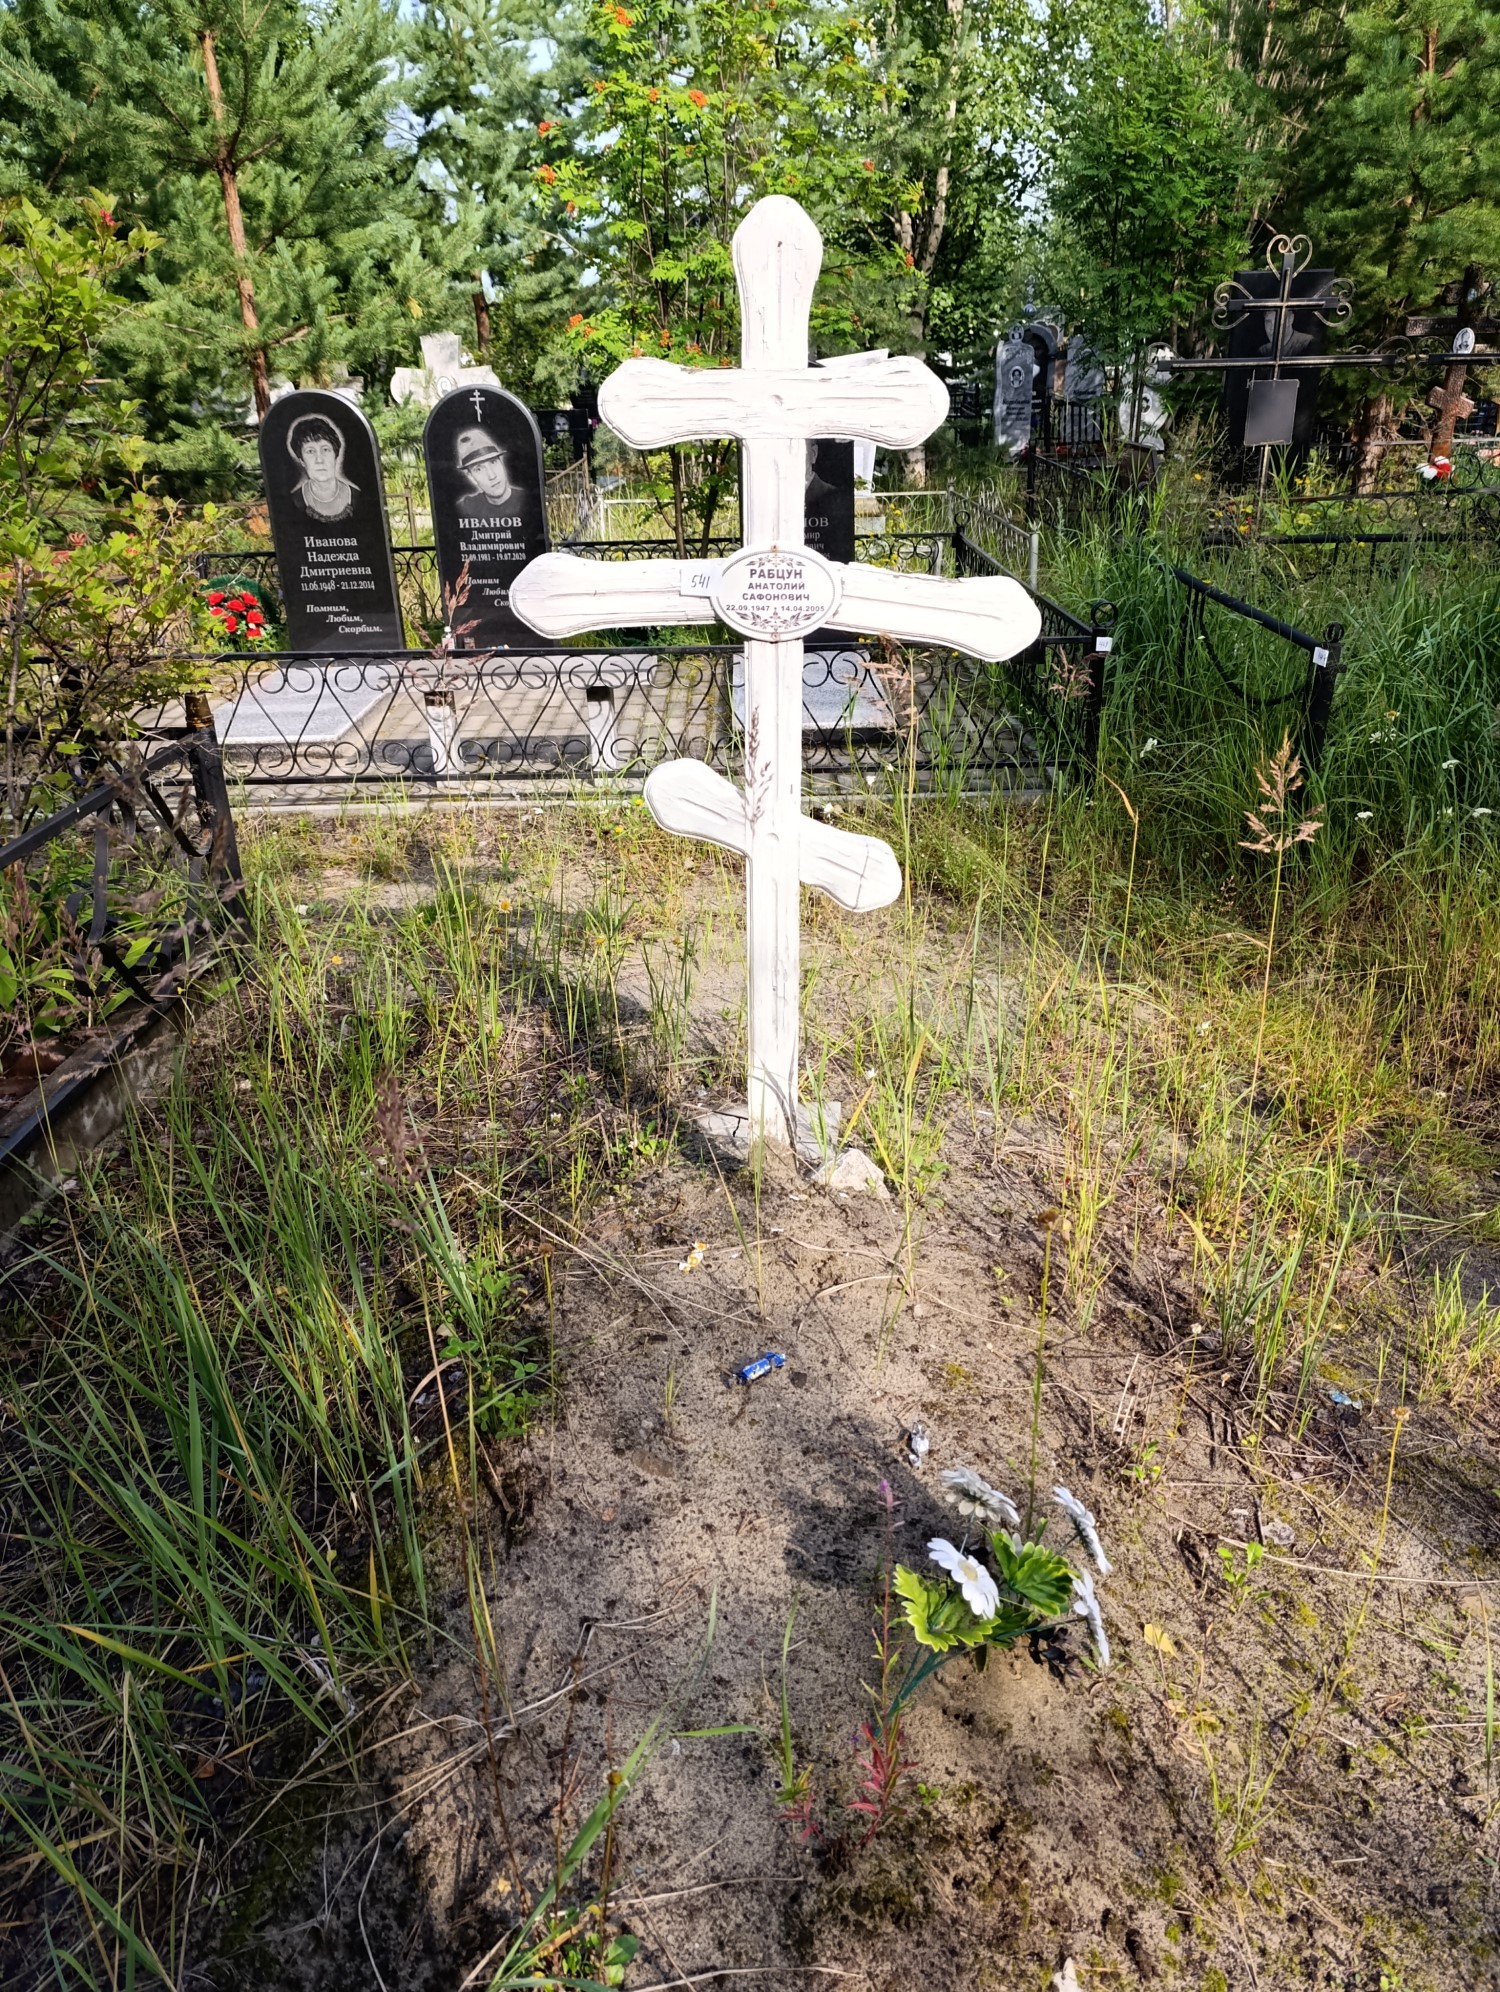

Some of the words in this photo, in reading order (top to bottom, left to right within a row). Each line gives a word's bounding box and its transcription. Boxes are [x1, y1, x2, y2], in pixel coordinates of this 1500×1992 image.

[458, 517, 522, 528] ИВАНОВ
[471, 530, 511, 541] Дмитрий
[304, 536, 358, 548] Иванова
[459, 542, 525, 552] Владимирович
[307, 551, 359, 562] Надежда
[300, 566, 372, 578] Дмитриевна
[749, 568, 803, 581] РАБЦУН
[301, 579, 336, 592] 11.06.1948
[340, 580, 375, 590] 21.12.2014
[691, 573, 711, 589] 541
[748, 581, 805, 590] АНАТОЛИЙ
[742, 592, 810, 601] САФОНОВИЧ
[306, 604, 349, 613] Помним,
[326, 614, 363, 623] Любим,
[338, 624, 383, 635] Скорбим.
